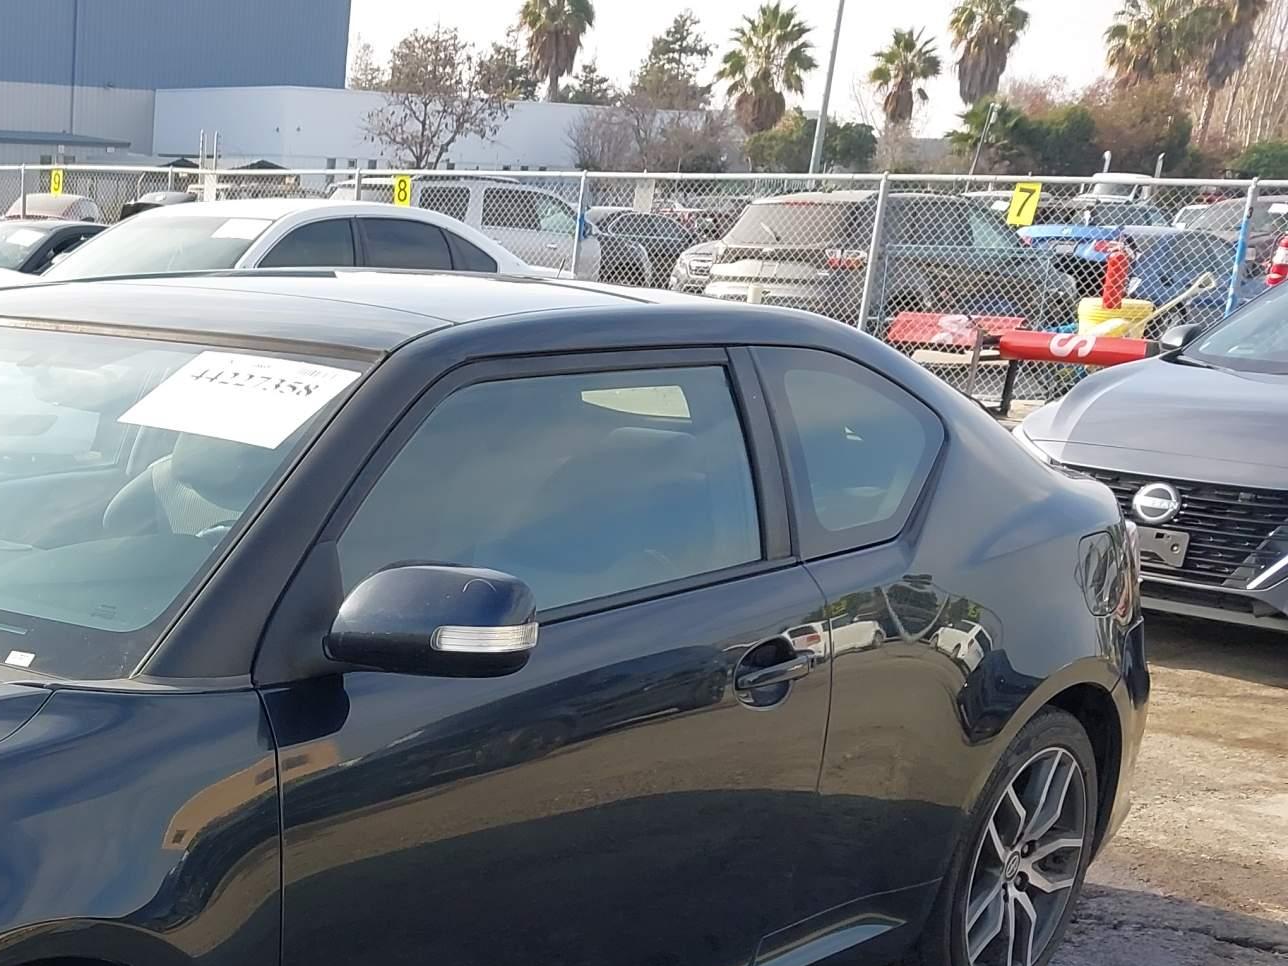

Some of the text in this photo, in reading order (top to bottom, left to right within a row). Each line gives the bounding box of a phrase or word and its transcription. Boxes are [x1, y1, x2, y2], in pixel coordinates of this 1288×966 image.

[53, 172, 61, 192] 9
[397, 179, 408, 202] 8
[1016, 187, 1037, 217] 7
[191, 368, 320, 397] 44227358
